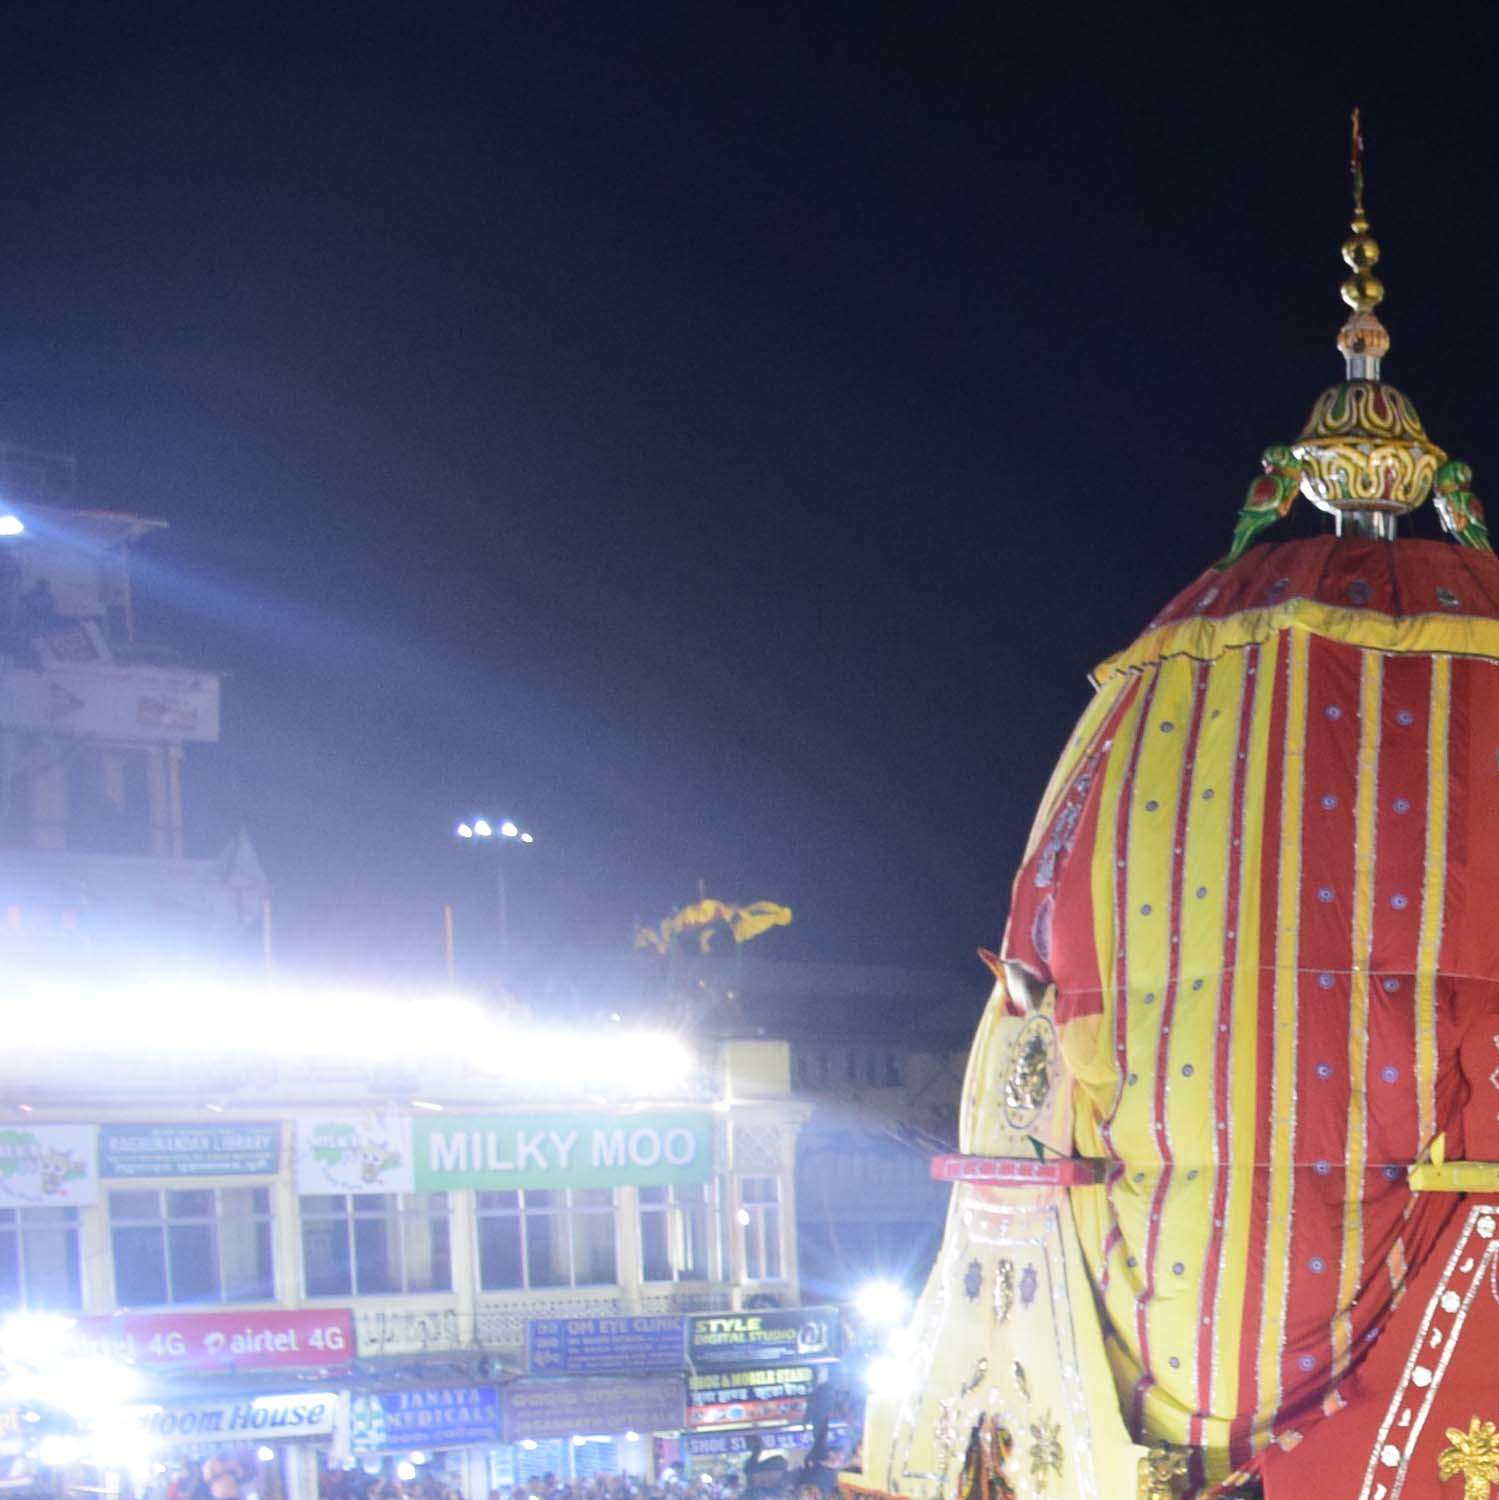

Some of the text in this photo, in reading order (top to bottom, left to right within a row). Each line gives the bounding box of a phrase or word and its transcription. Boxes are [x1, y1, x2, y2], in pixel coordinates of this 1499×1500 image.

[429, 1128, 696, 1171] MILKY MOO
[695, 1316, 762, 1333] STYLE
[748, 1328, 797, 1343] STUDIO
[149, 1331, 187, 1356] 4G
[230, 1328, 300, 1354] airtel
[308, 1326, 345, 1351] 4G
[400, 1388, 481, 1410] JANATA
[229, 1402, 325, 1431] House
